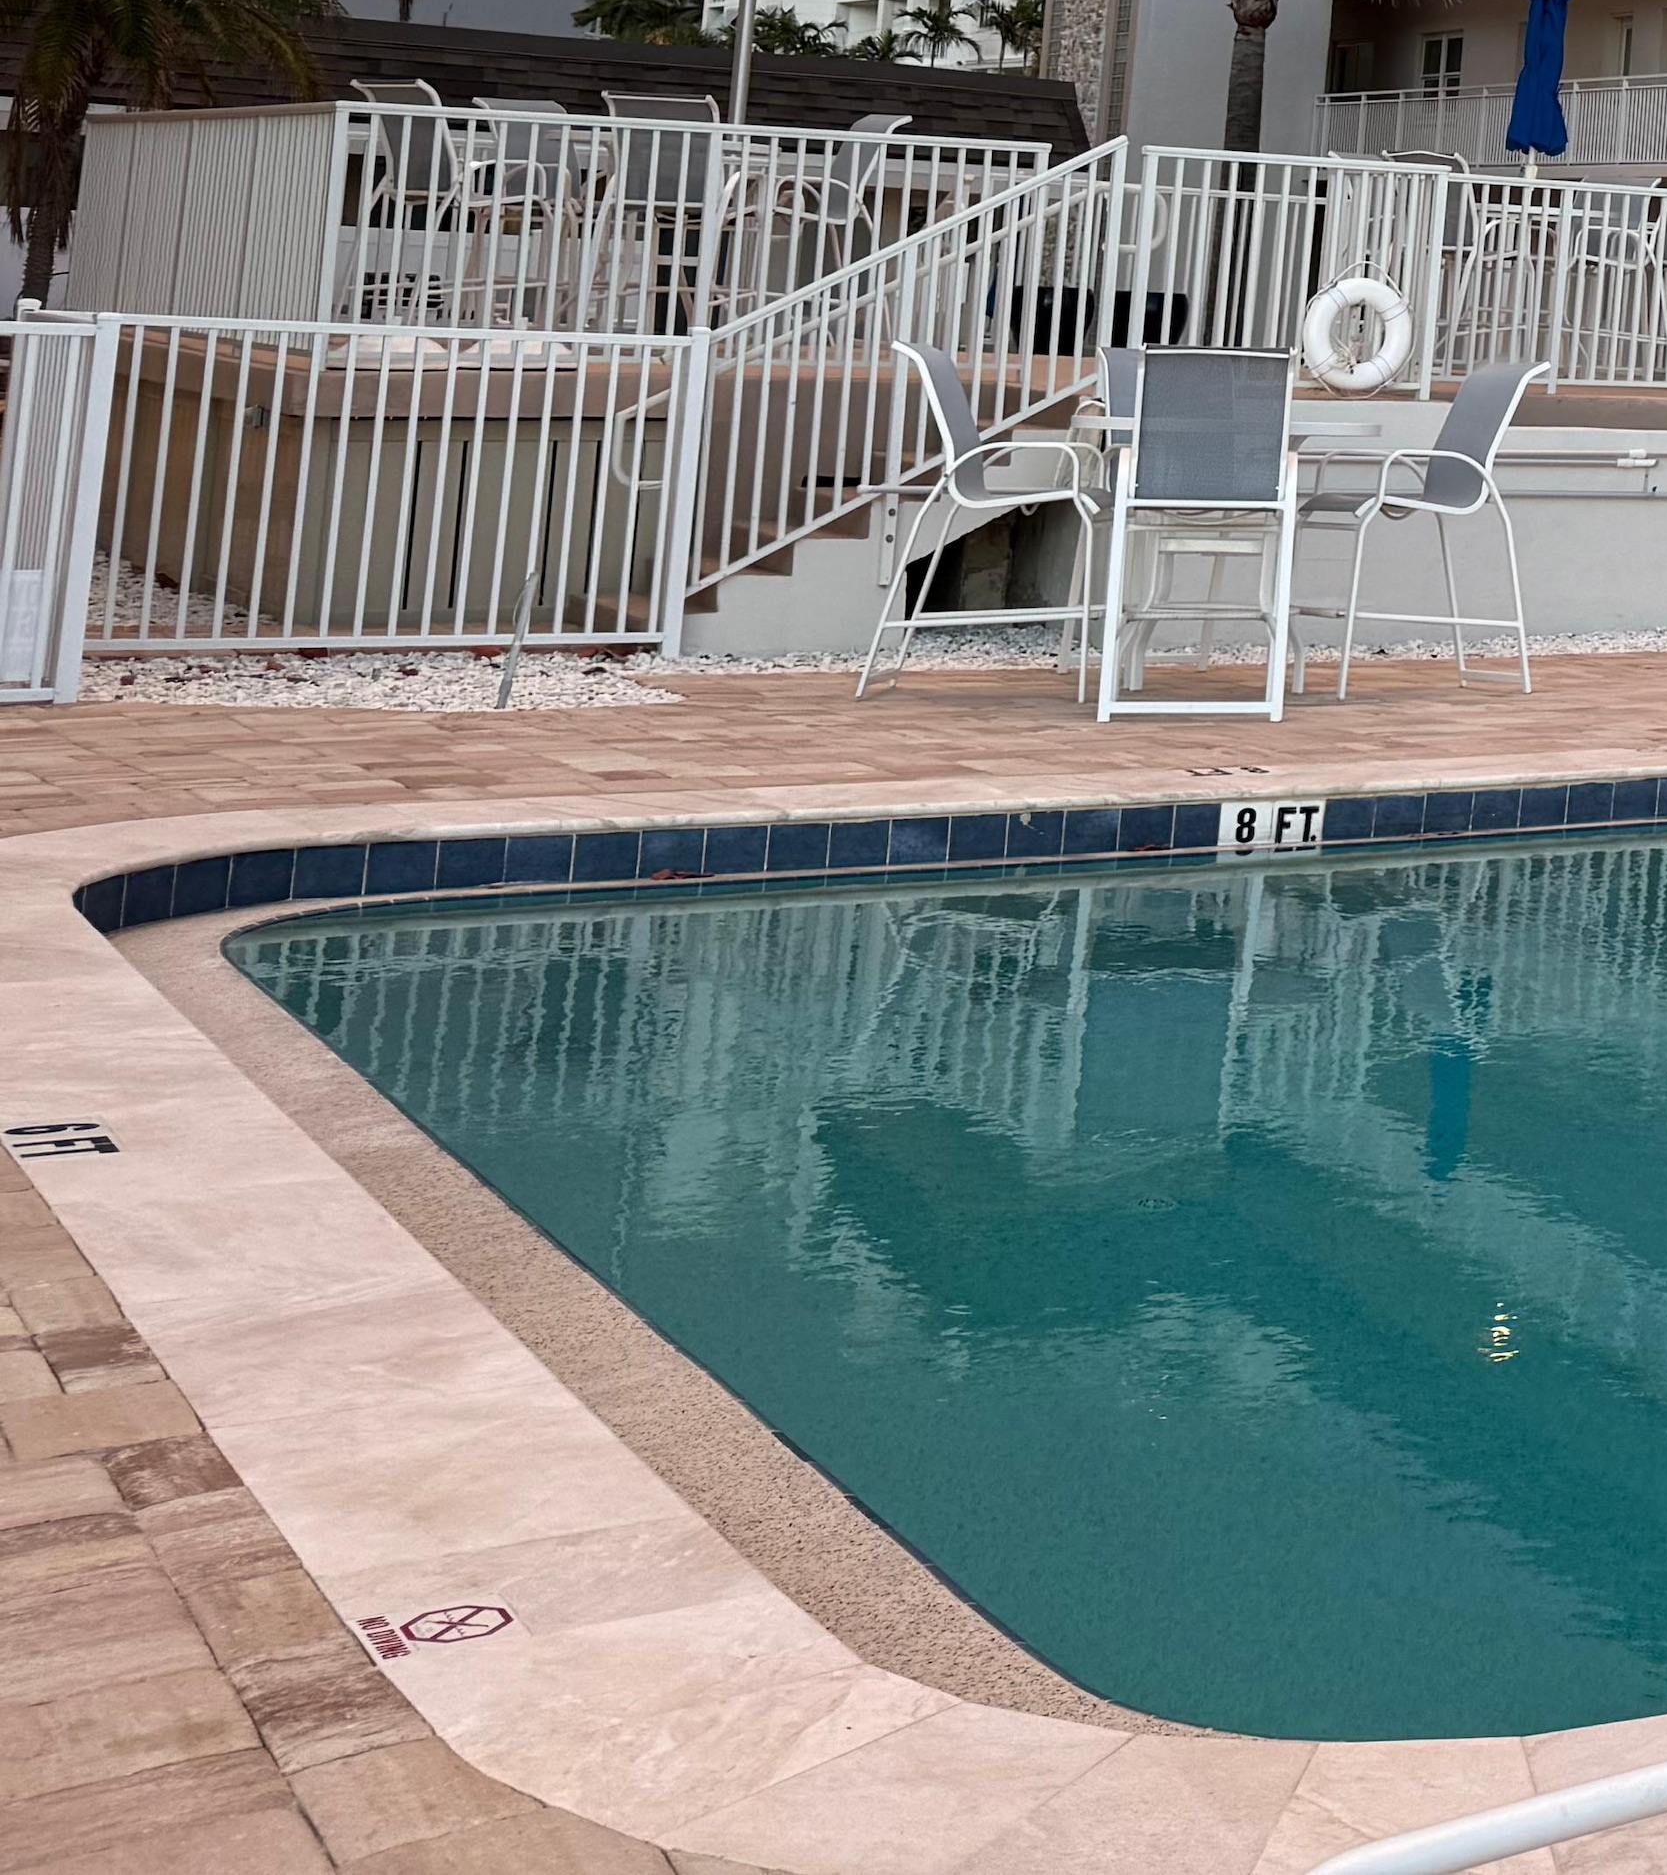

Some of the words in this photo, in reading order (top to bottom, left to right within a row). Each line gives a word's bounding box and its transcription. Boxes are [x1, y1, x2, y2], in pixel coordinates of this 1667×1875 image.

[1235, 807, 1257, 844] 8
[4, 1123, 100, 1135] 6
[12, 1135, 121, 1158] FT
[355, 1615, 391, 1631] NO
[366, 1628, 412, 1660] DIVING
